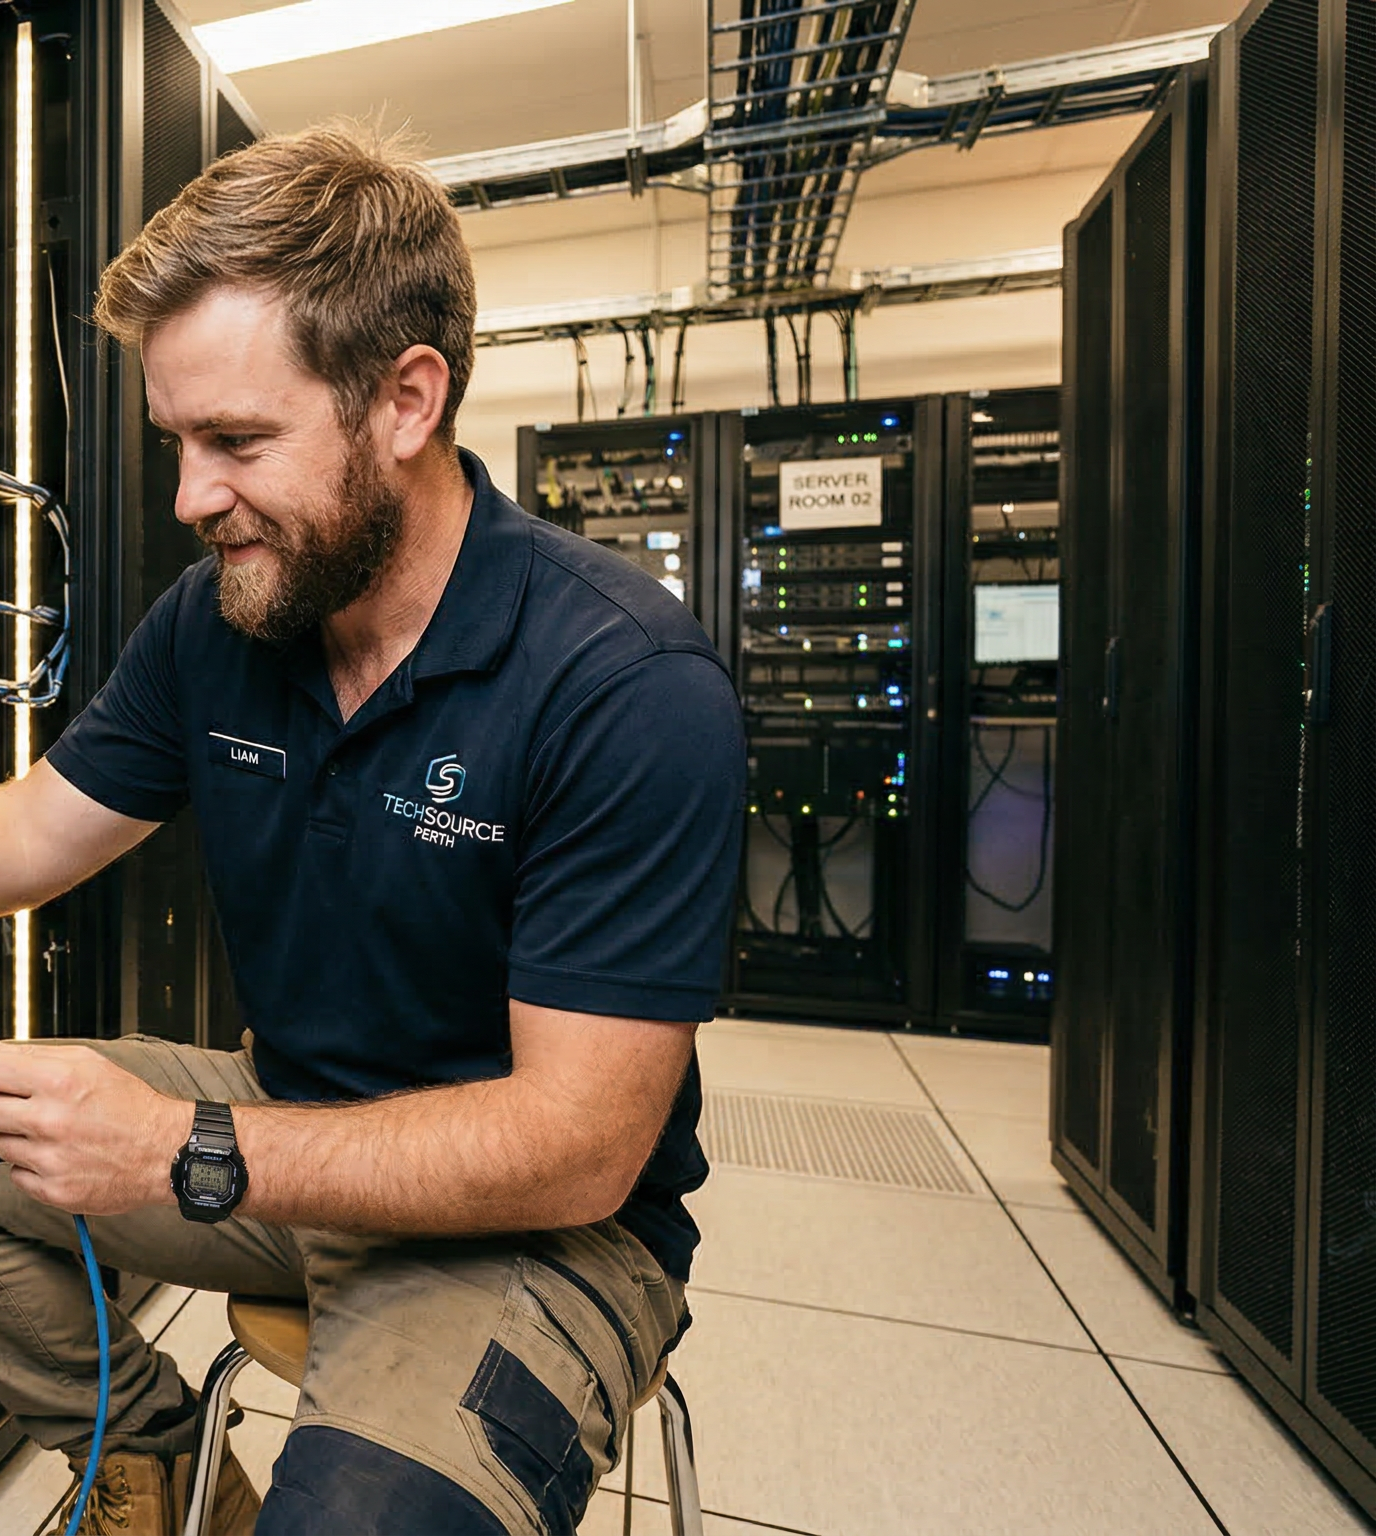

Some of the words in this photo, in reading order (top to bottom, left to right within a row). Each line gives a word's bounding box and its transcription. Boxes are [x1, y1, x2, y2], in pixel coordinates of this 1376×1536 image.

[793, 472, 869, 490] SERVER
[789, 494, 845, 511] ROOM
[851, 492, 872, 506] 02
[230, 747, 259, 766] LIAM
[383, 792, 505, 842] TECHSOURCE
[414, 825, 455, 849] PERTH
